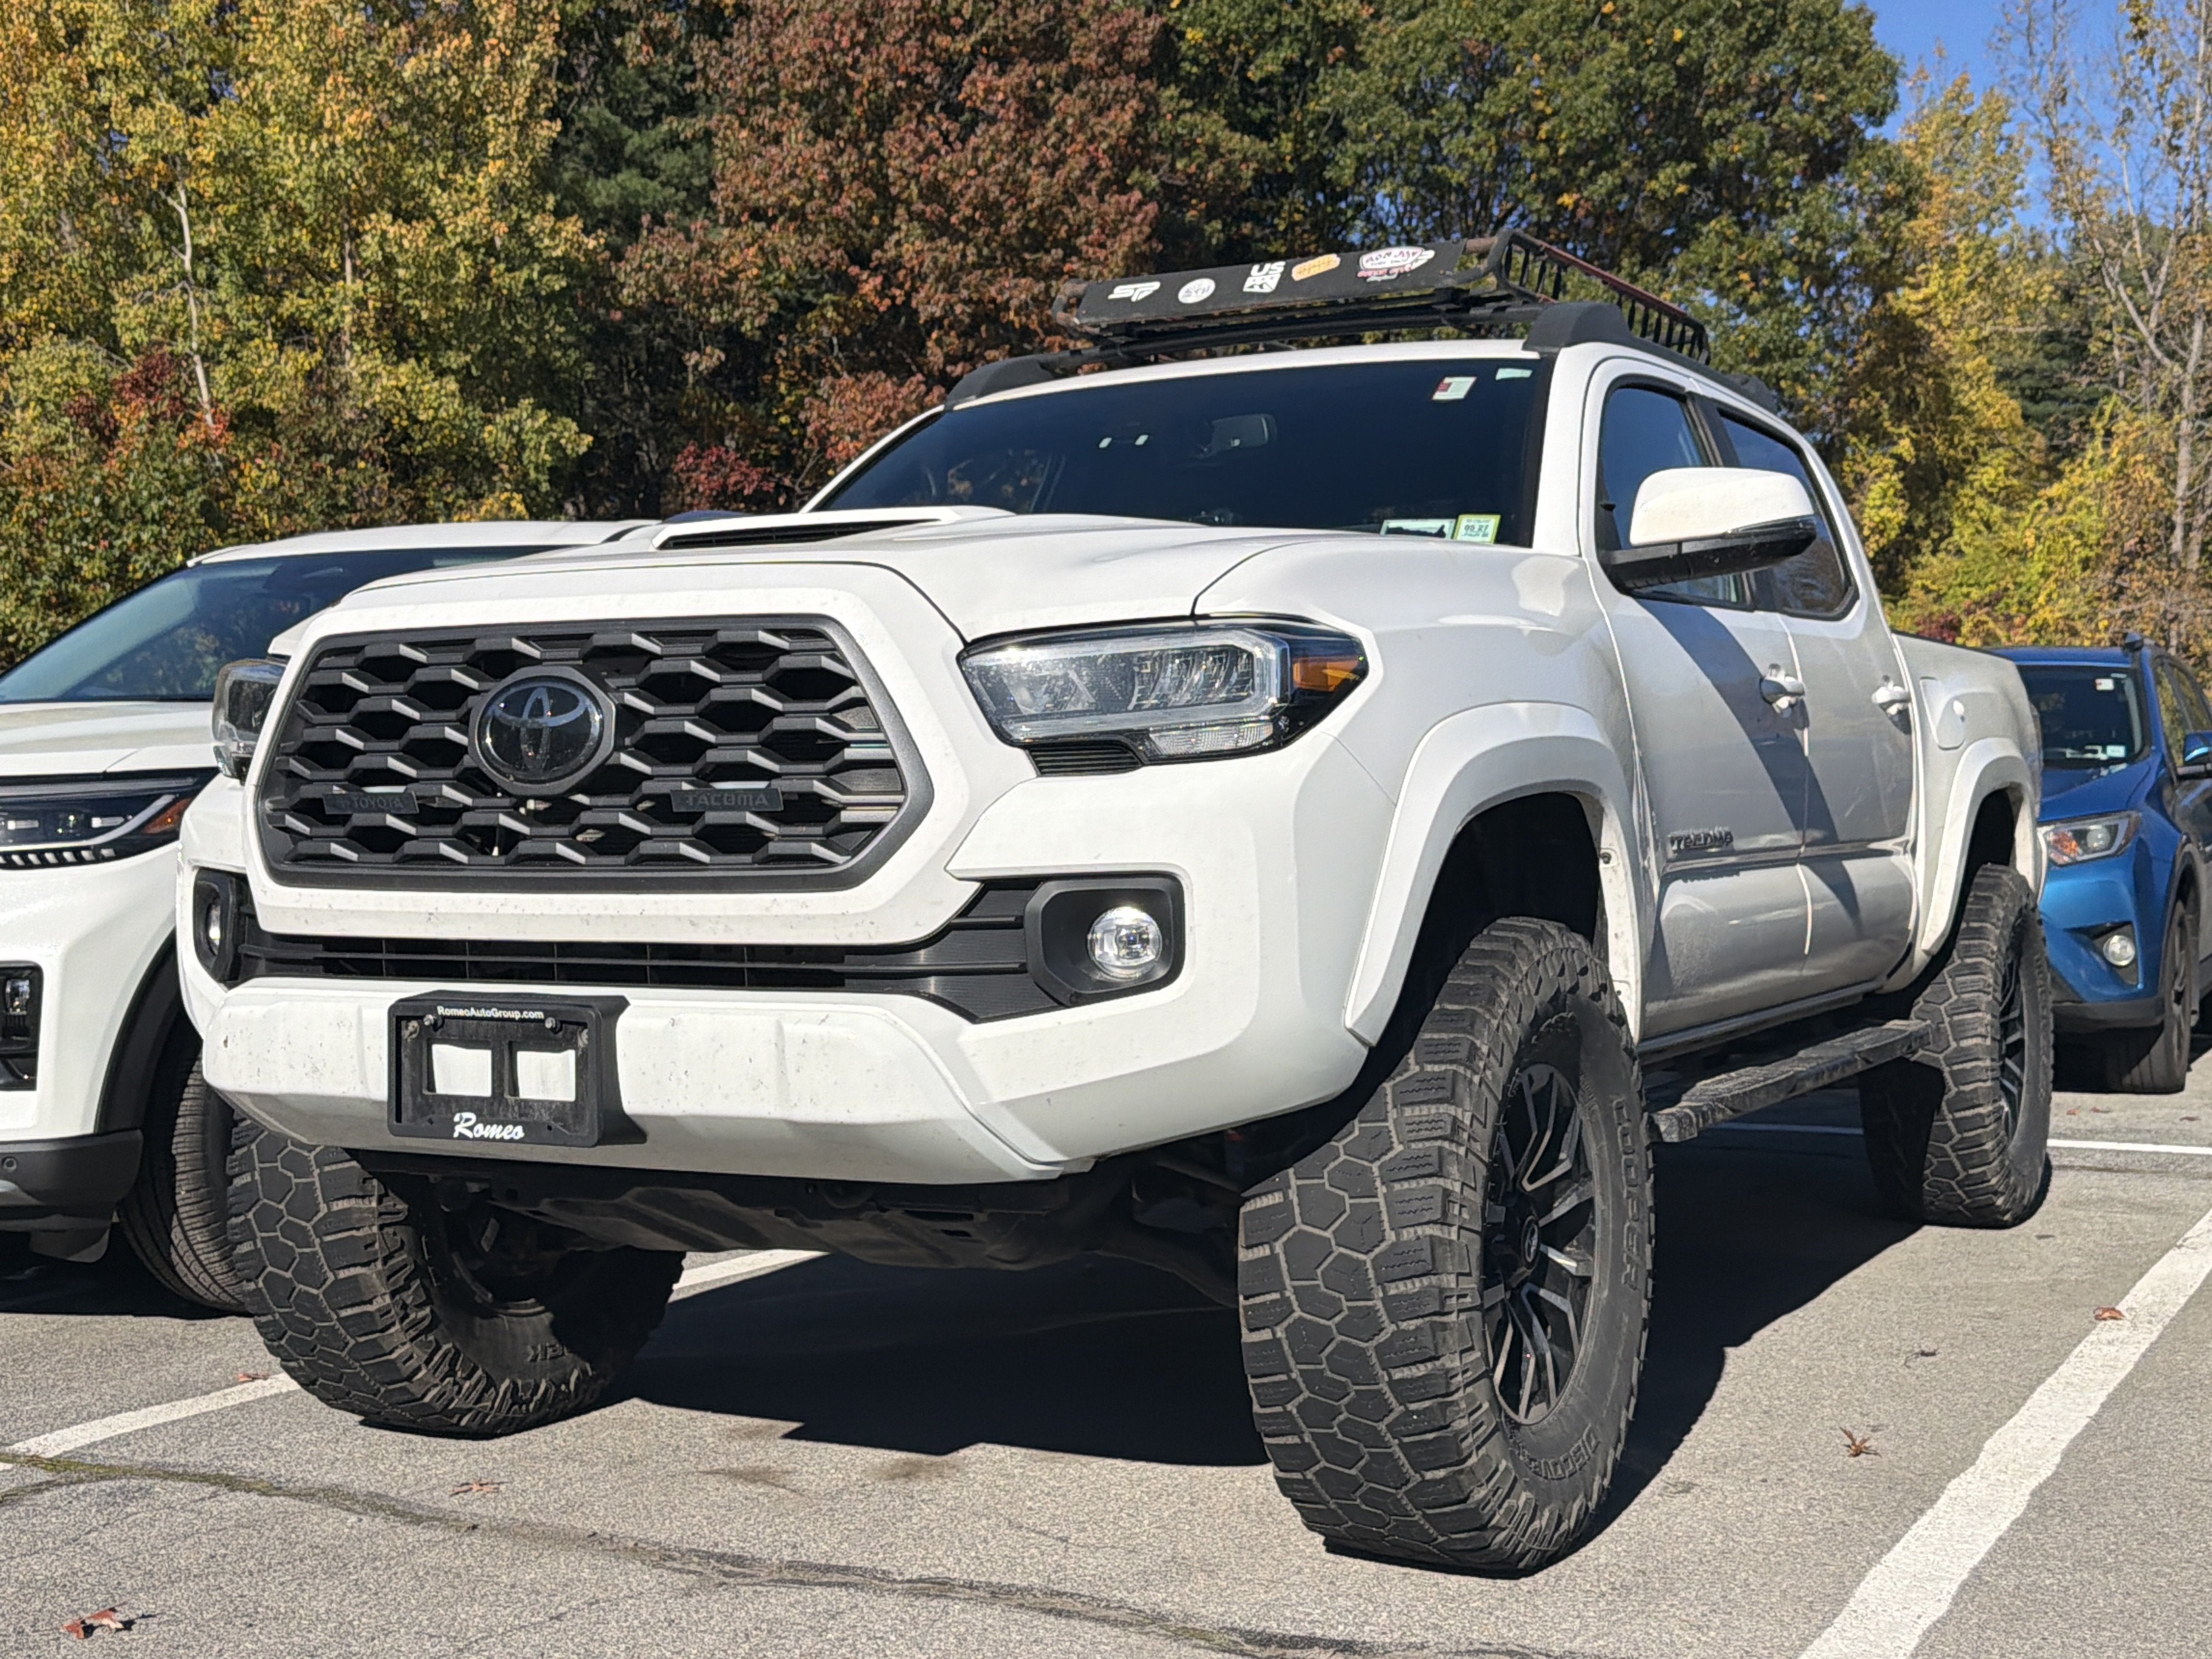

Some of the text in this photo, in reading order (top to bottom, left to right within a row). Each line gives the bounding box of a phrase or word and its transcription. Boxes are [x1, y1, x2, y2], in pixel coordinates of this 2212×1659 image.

[1251, 261, 1286, 276] US
[685, 793, 769, 808] TACOMA
[437, 1006, 544, 1020] RomeoAutoGroup.com
[453, 1111, 525, 1141] Romeo
